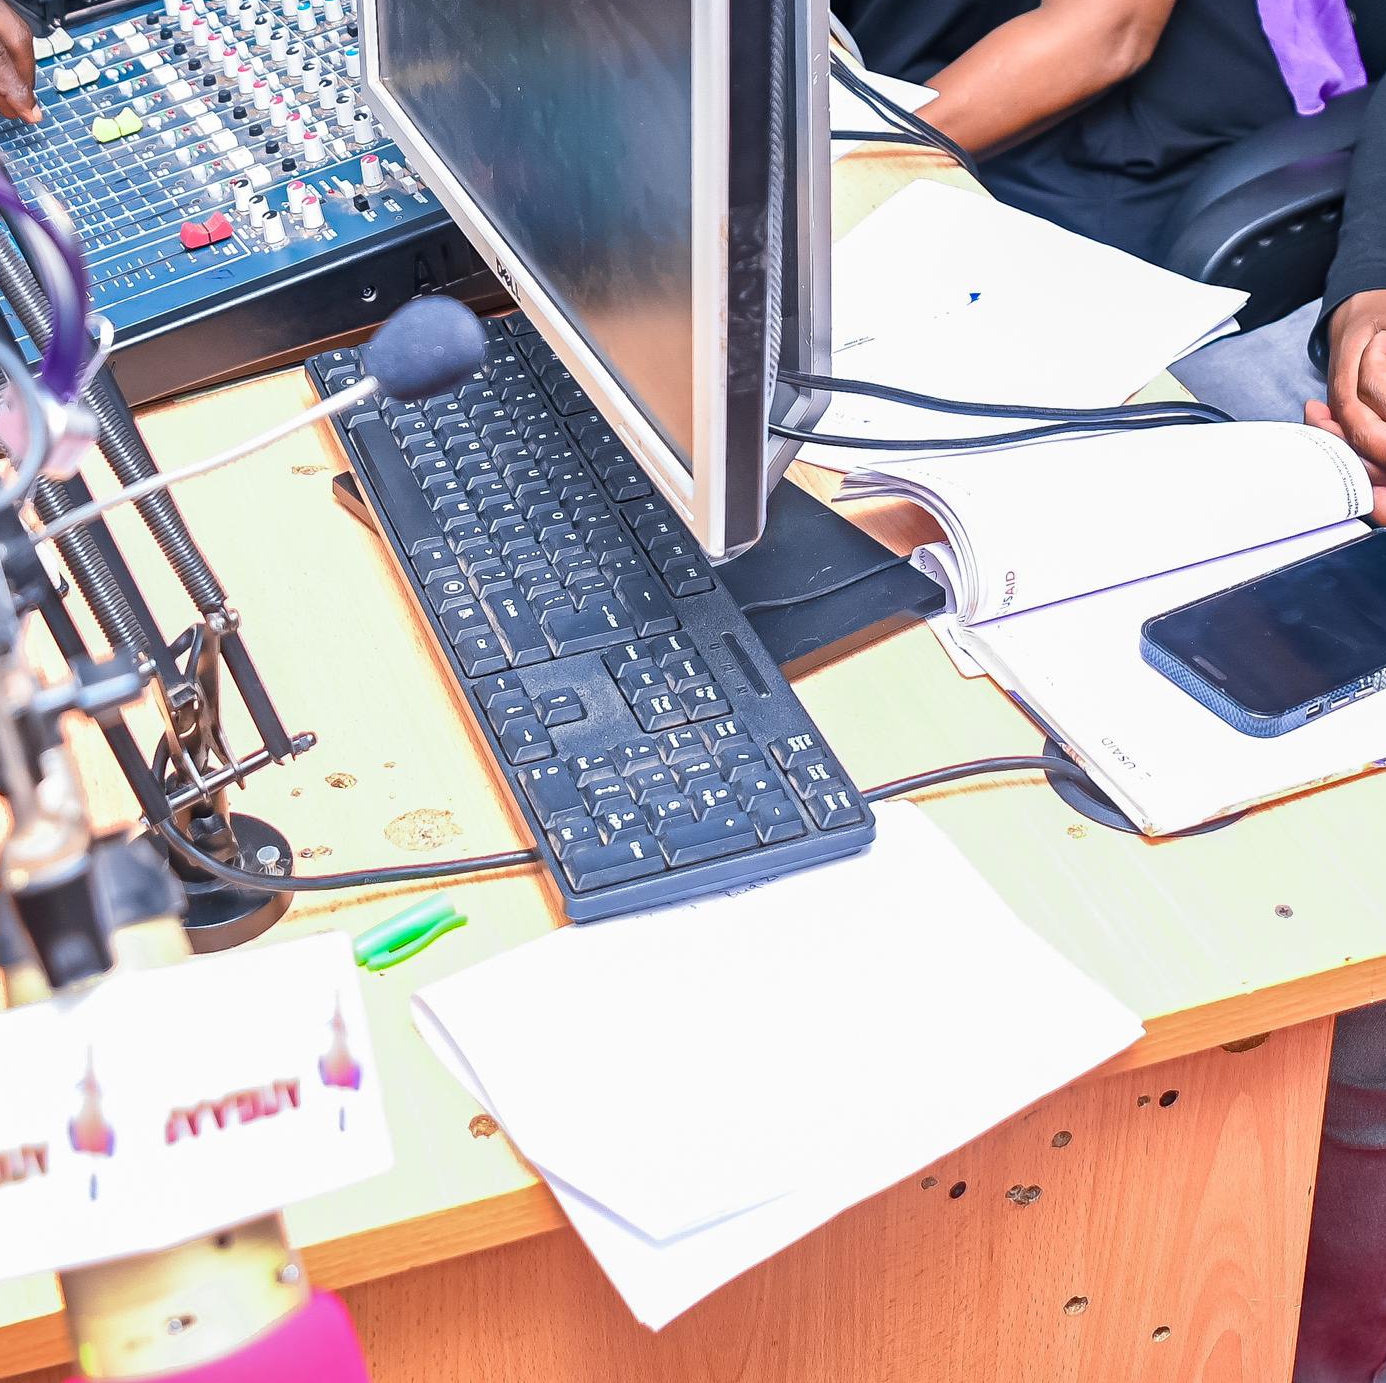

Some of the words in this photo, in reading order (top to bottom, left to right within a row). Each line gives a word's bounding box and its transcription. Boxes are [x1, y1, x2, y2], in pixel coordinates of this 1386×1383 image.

[495, 256, 522, 303] DELL
[999, 570, 1016, 611] USAID
[1101, 736, 1136, 770] USAID
